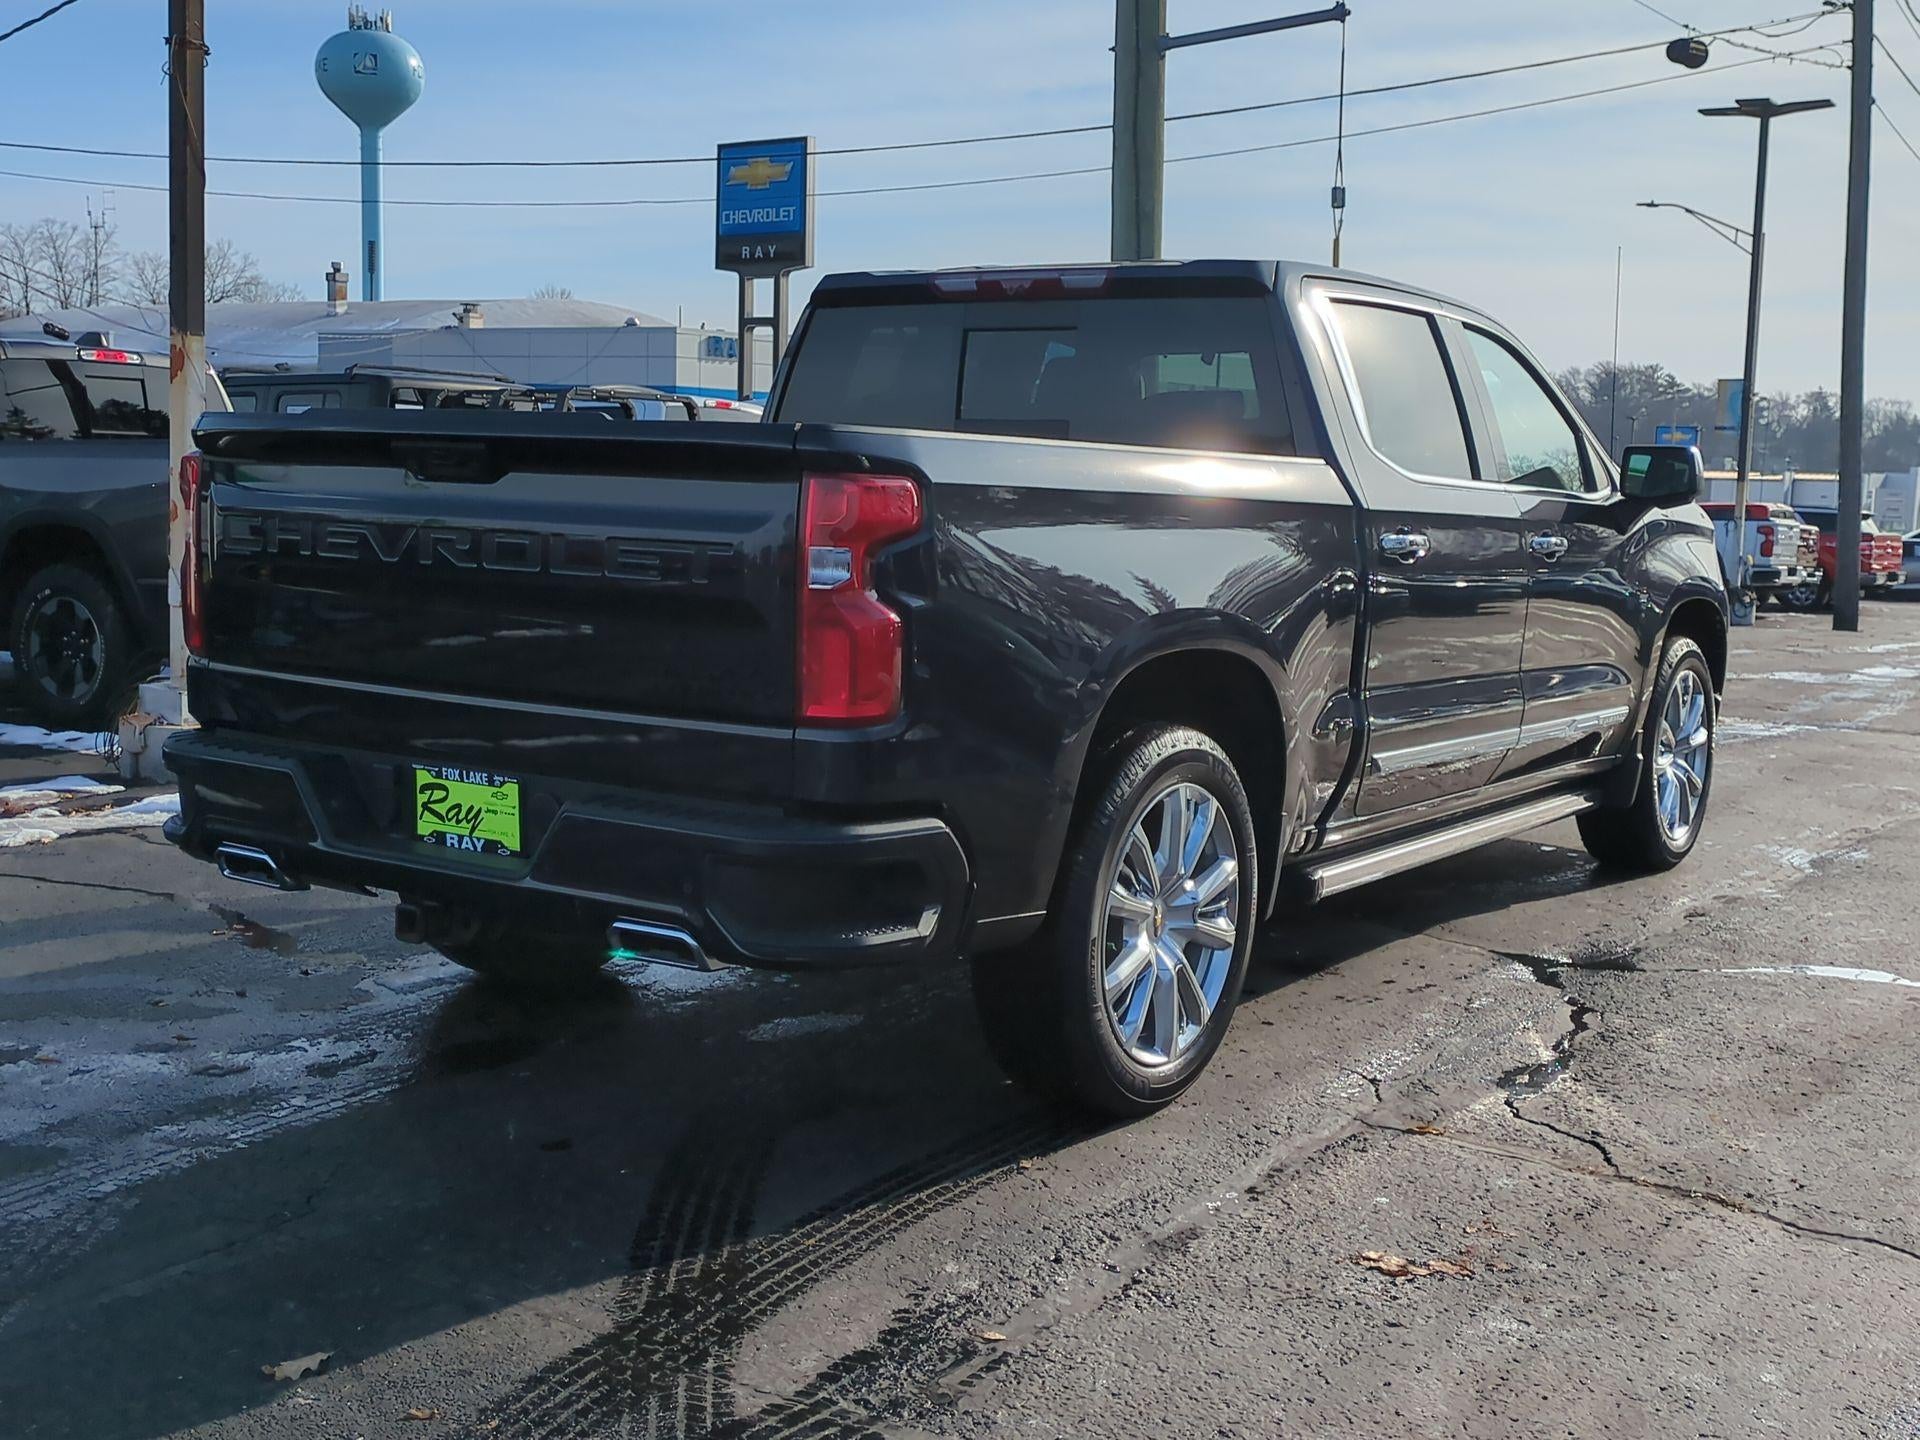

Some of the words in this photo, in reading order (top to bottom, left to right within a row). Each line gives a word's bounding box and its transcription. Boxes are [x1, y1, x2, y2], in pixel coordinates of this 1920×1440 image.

[722, 206, 796, 224] CHEVROLET
[742, 245, 776, 259] RAY
[707, 336, 738, 358] RA
[223, 513, 734, 583] CHEVROLET
[442, 767, 460, 781] FOX
[463, 770, 488, 785] LAKE
[419, 782, 484, 836] Ray
[446, 833, 485, 852] RAY
